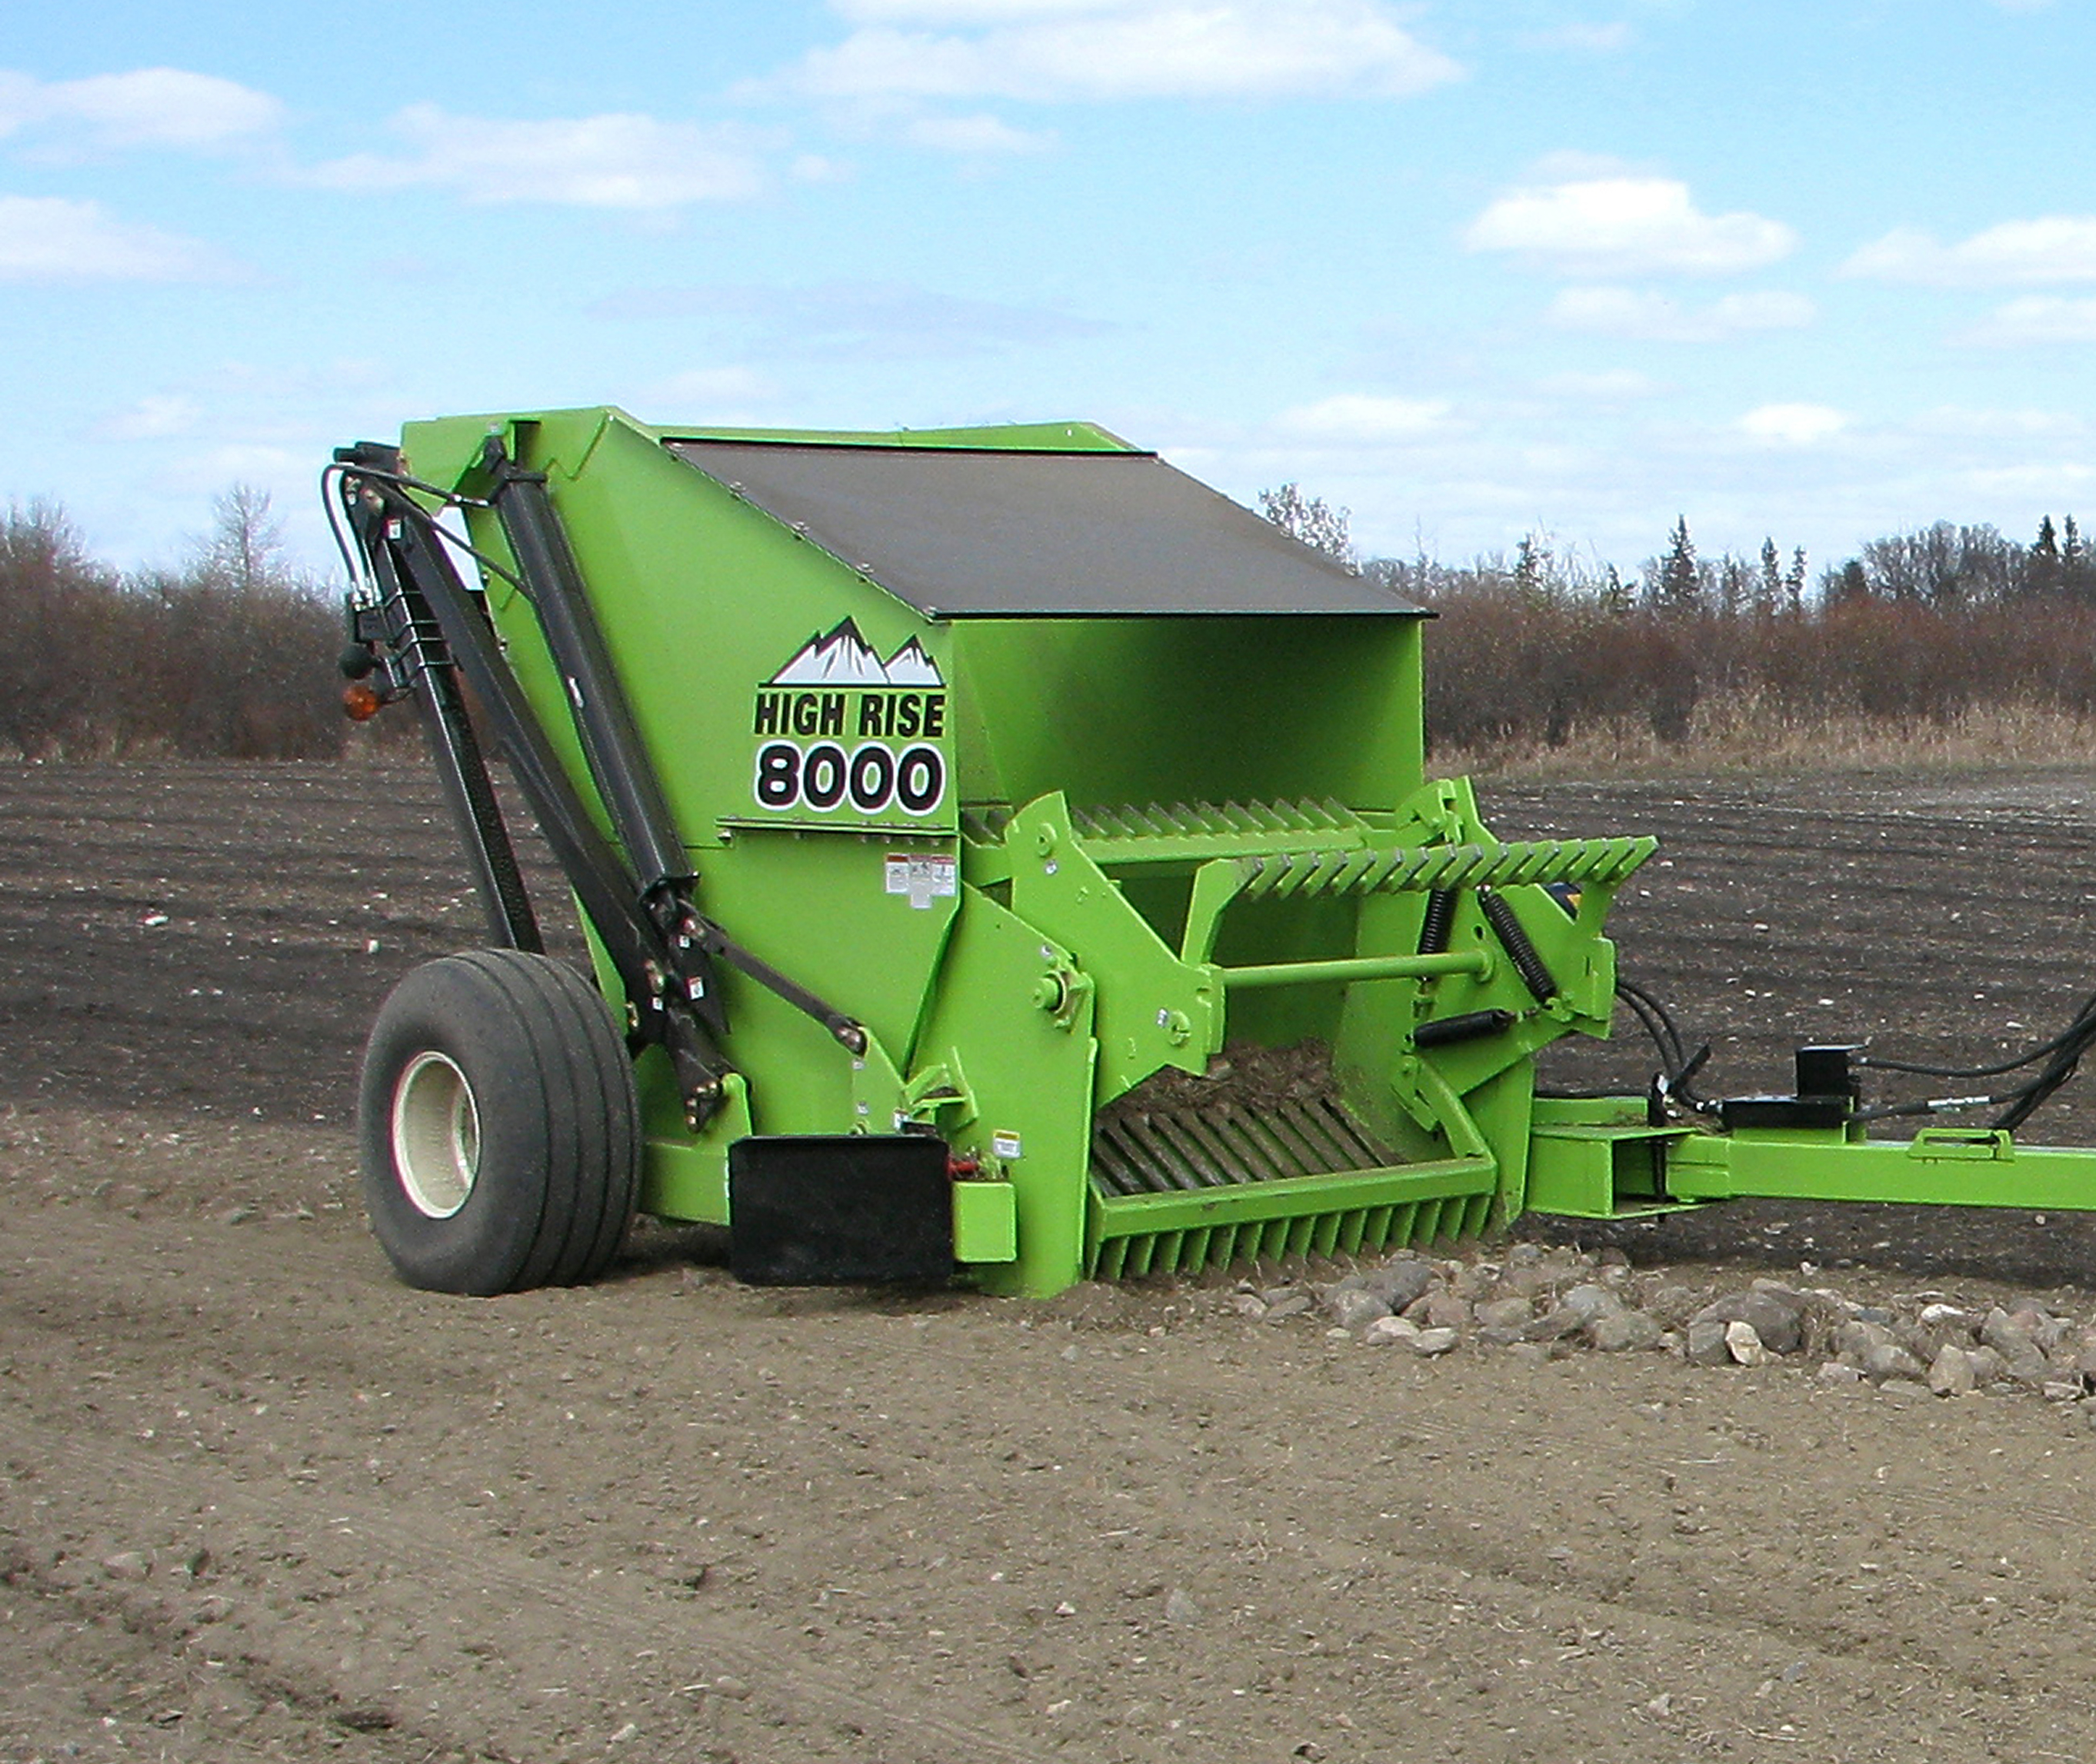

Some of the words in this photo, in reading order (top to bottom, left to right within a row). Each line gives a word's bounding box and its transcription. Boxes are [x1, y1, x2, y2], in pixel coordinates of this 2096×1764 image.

[754, 694, 845, 735] HIGH
[858, 694, 945, 738] RISE
[755, 741, 945, 815] 8000
